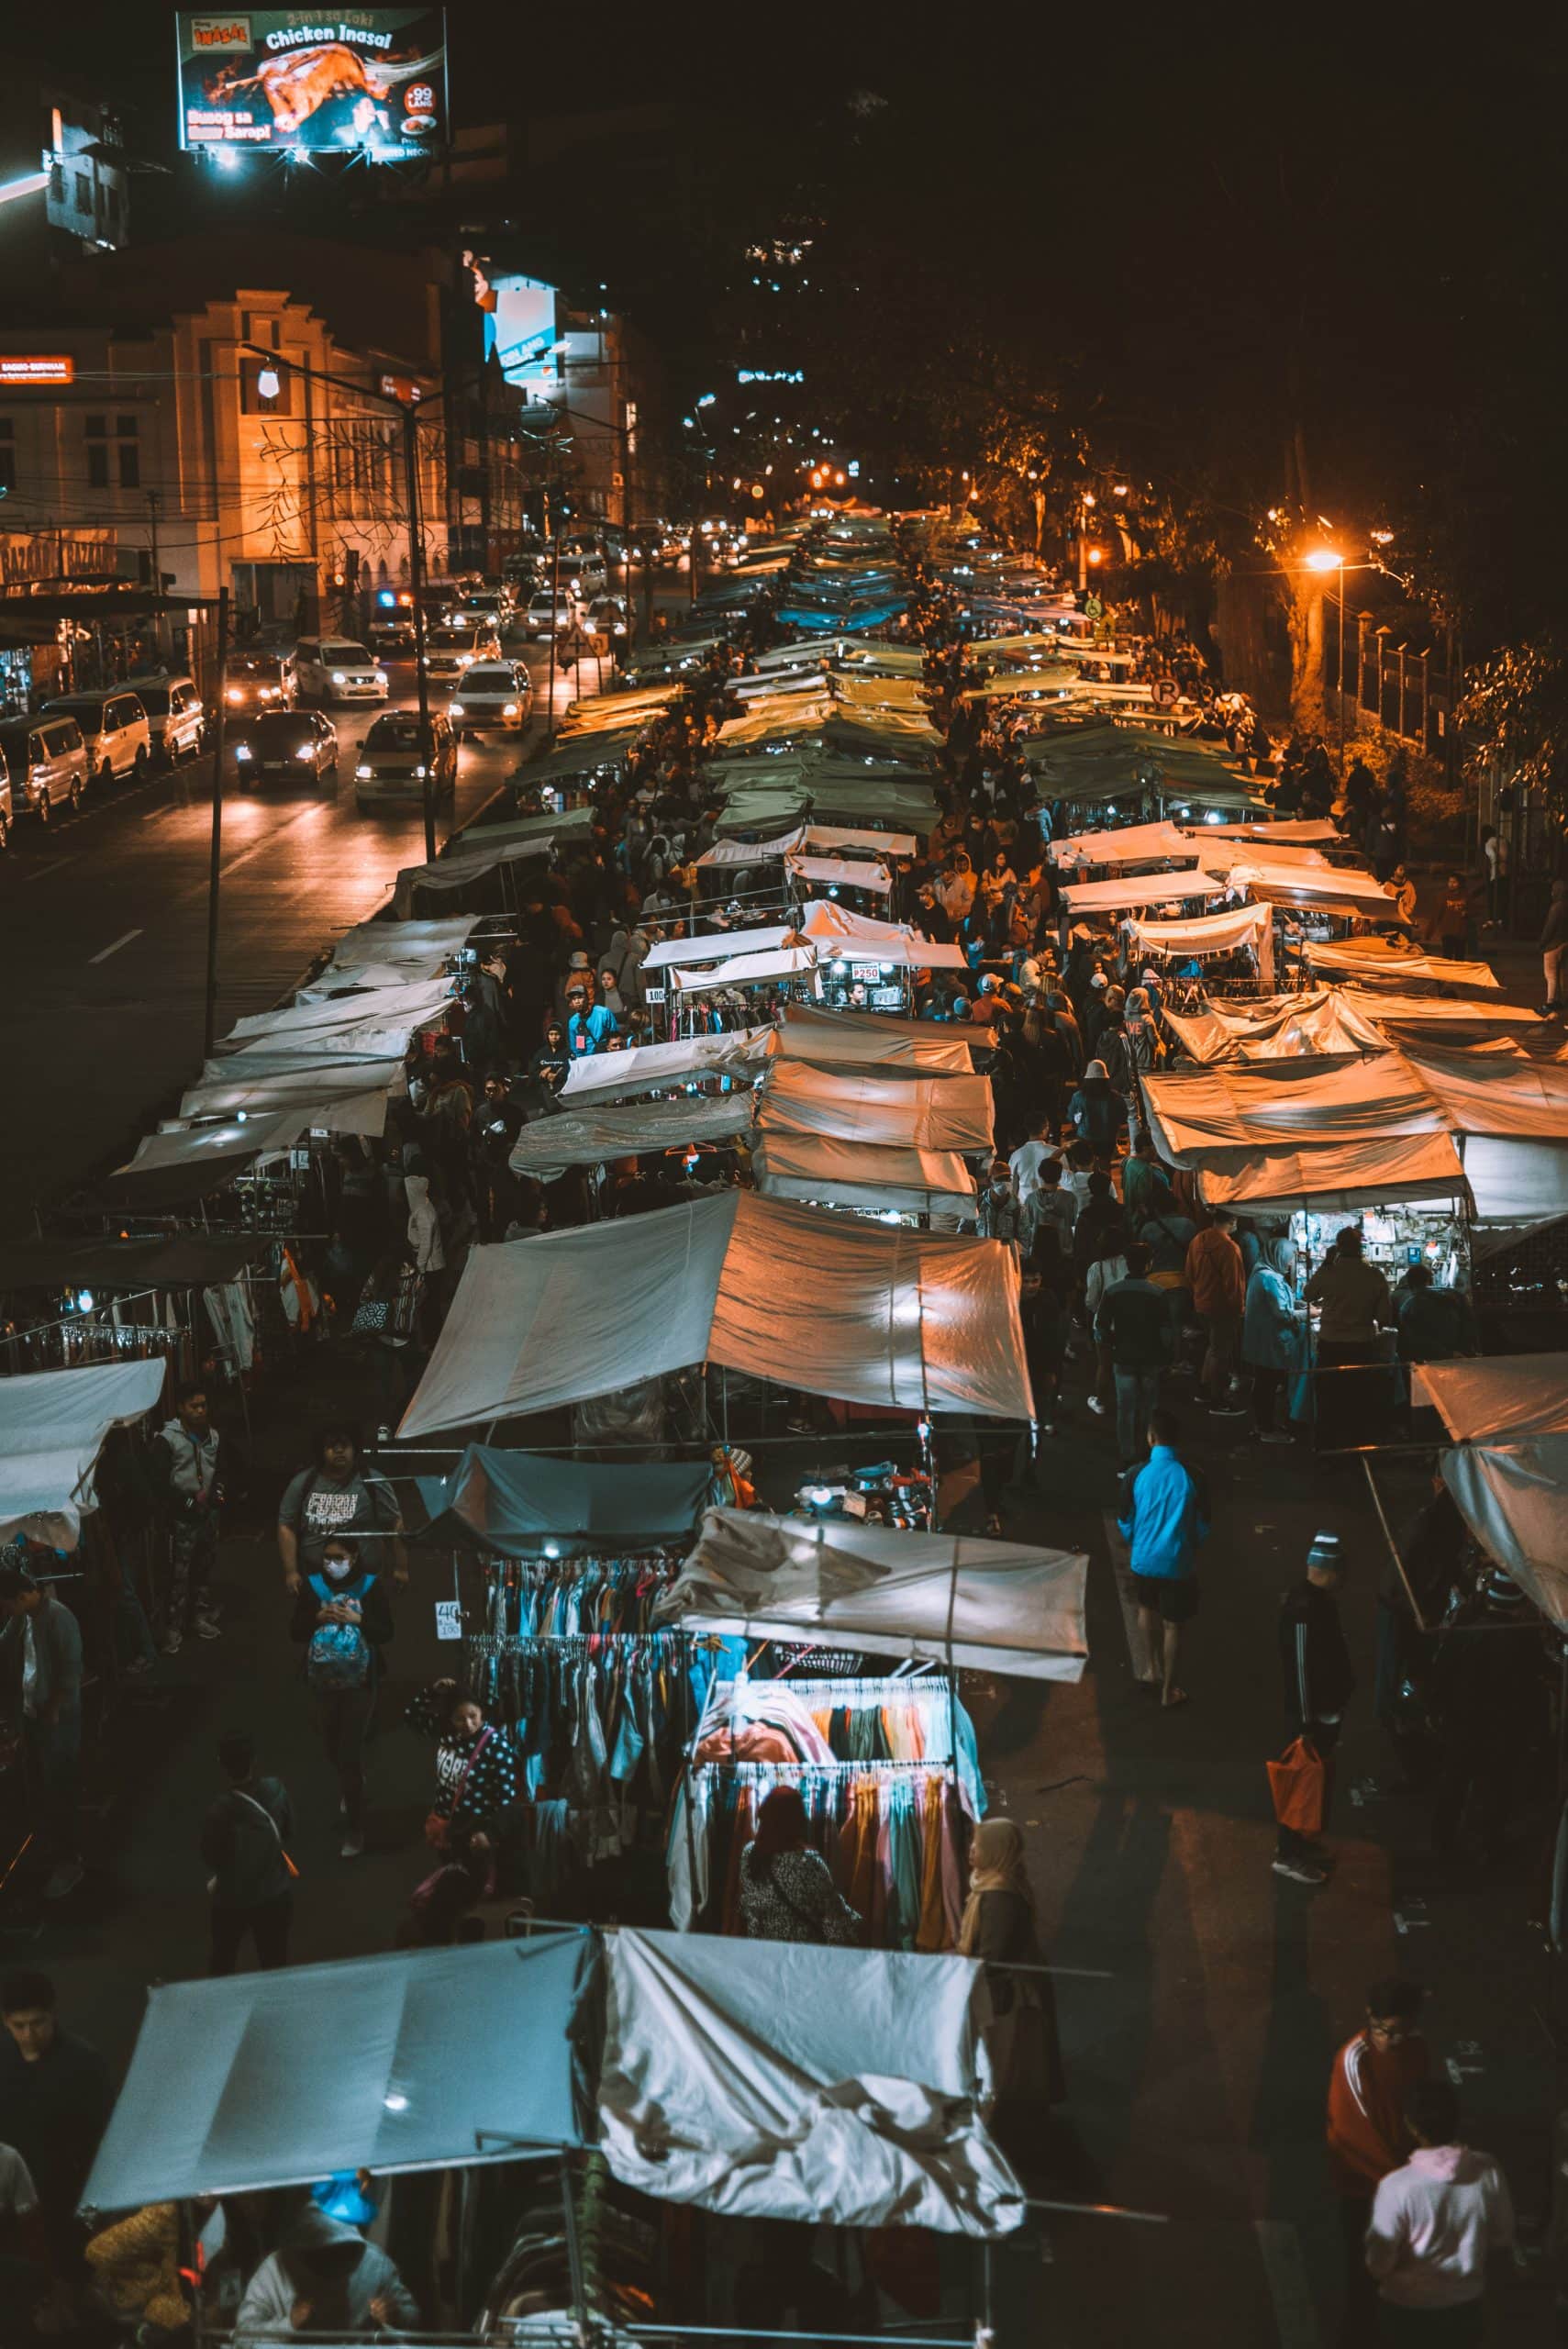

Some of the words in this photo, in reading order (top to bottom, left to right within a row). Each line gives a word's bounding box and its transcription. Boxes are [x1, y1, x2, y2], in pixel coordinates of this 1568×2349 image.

[194, 23, 249, 45] INASAL
[266, 26, 335, 50] Chicken
[339, 24, 393, 49] Inasal
[1158, 682, 1175, 702] P
[650, 990, 663, 1001] 100
